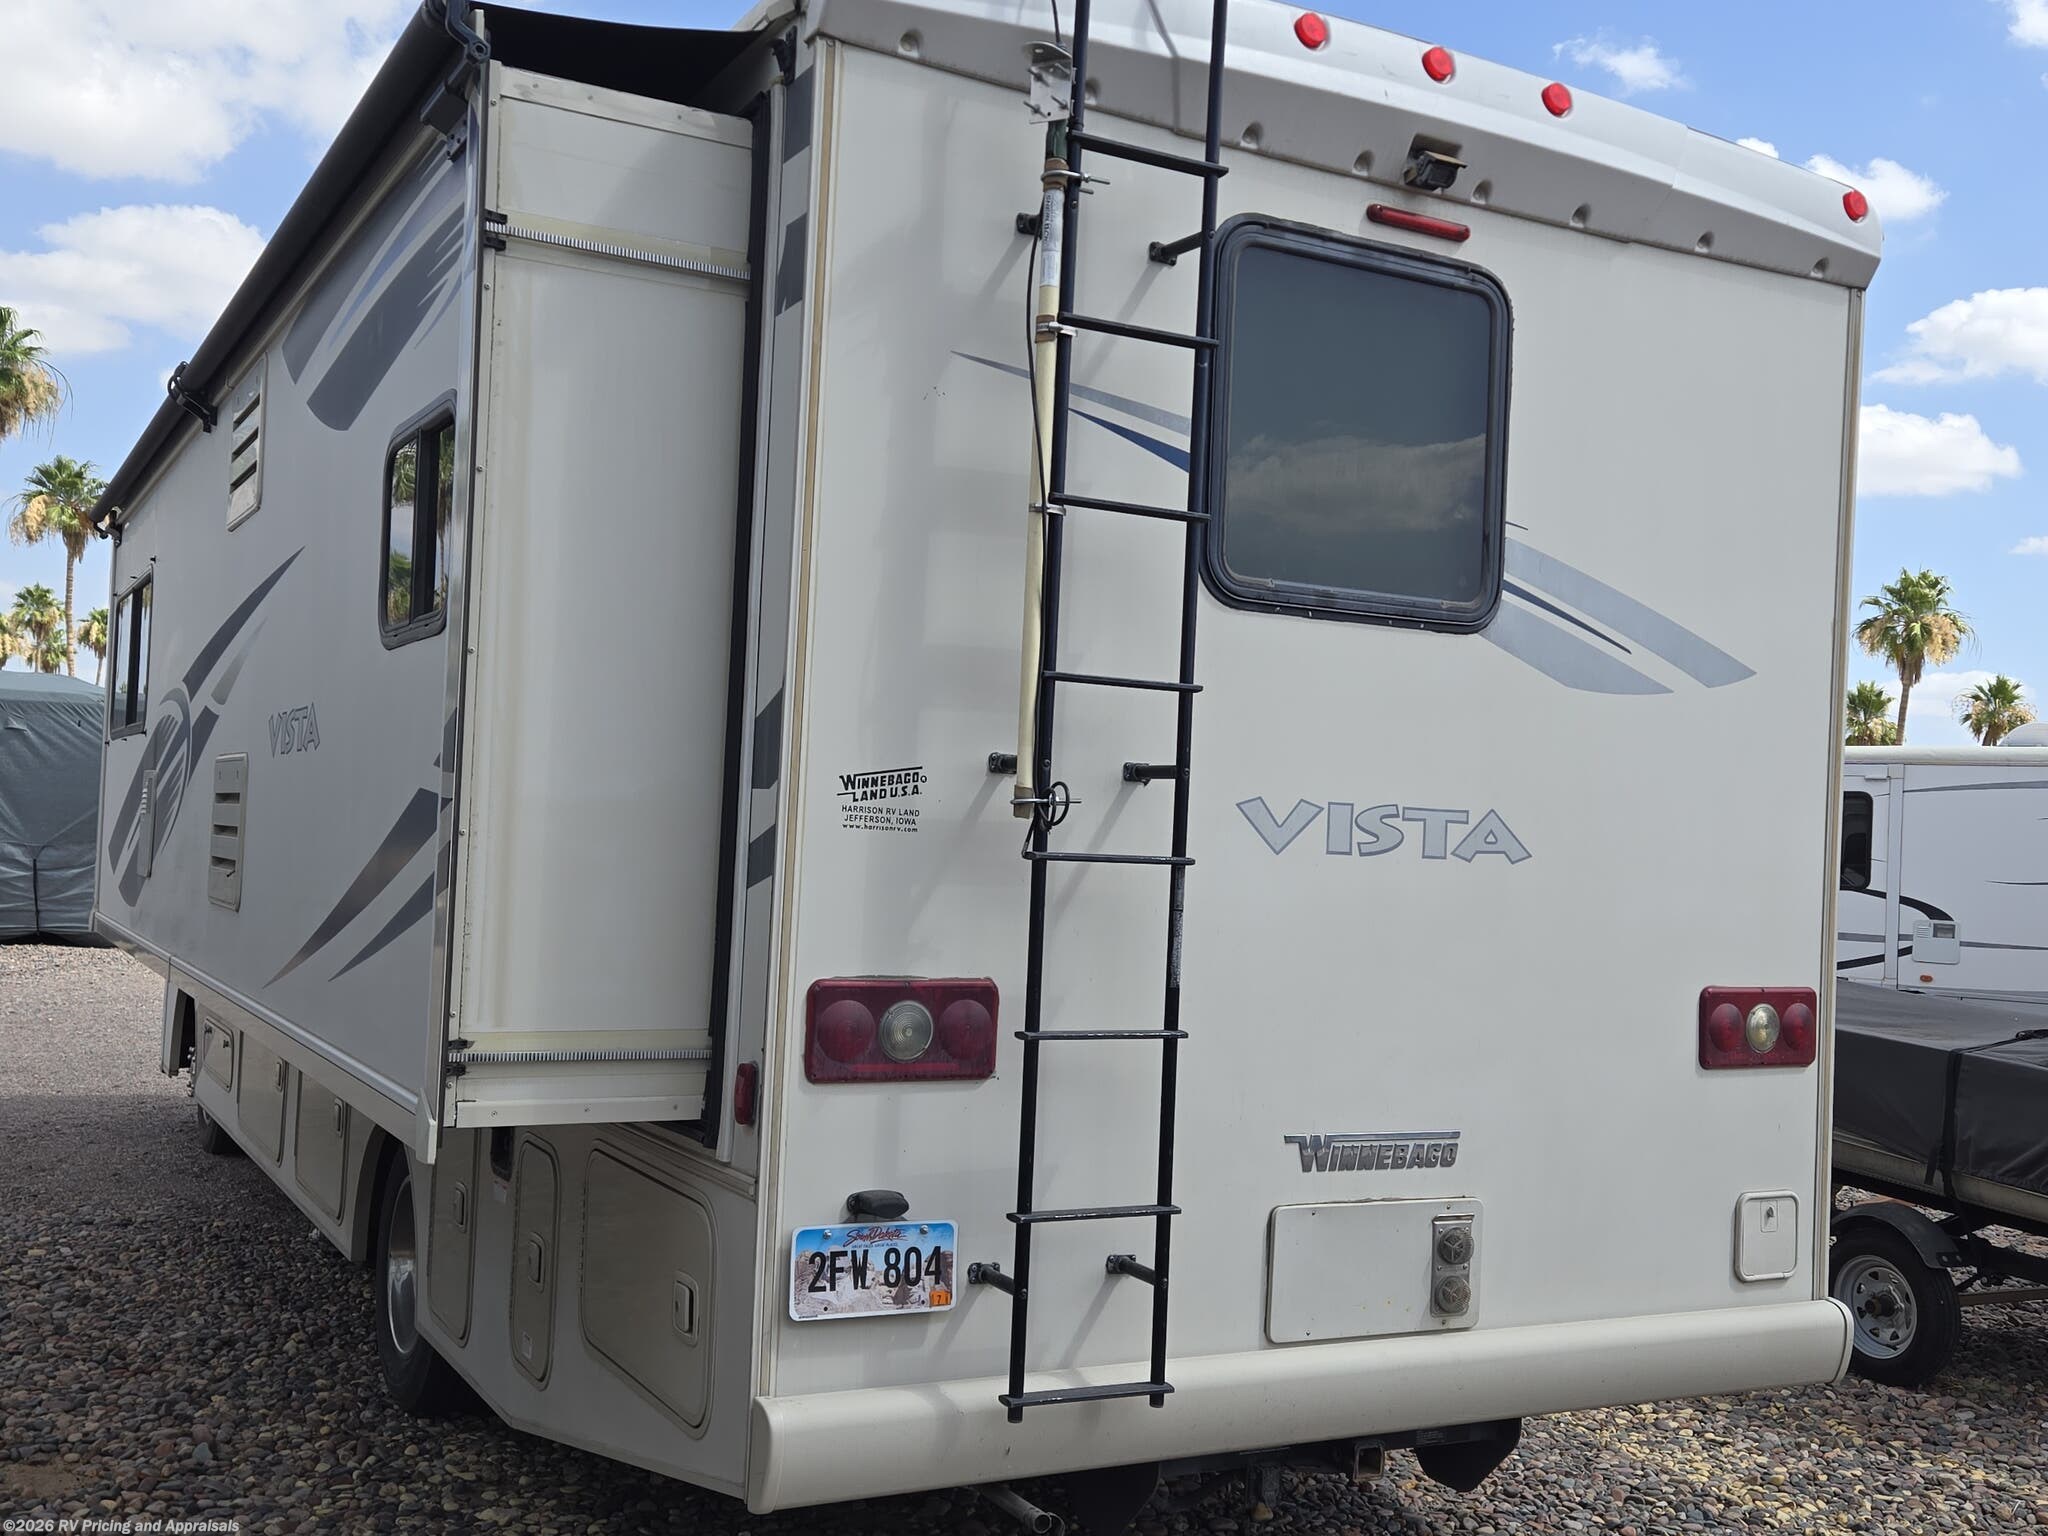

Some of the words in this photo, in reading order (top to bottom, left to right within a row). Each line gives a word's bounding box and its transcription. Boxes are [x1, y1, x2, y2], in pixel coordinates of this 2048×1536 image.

[268, 701, 320, 759] VISTA
[849, 788, 887, 802] LAND
[890, 784, 922, 798] U.S.A.
[841, 804, 883, 815] HARRISON
[886, 807, 897, 816] RV
[899, 808, 920, 817] LAND
[844, 814, 893, 825] JEFFERSON,
[896, 817, 917, 826] IOWA
[842, 823, 918, 833] www.harrisonrv.com
[1236, 796, 1532, 865] VISTA
[1284, 1131, 1461, 1173] WINNEBAGO
[808, 1249, 870, 1293] 2FW
[884, 1245, 942, 1288] 804
